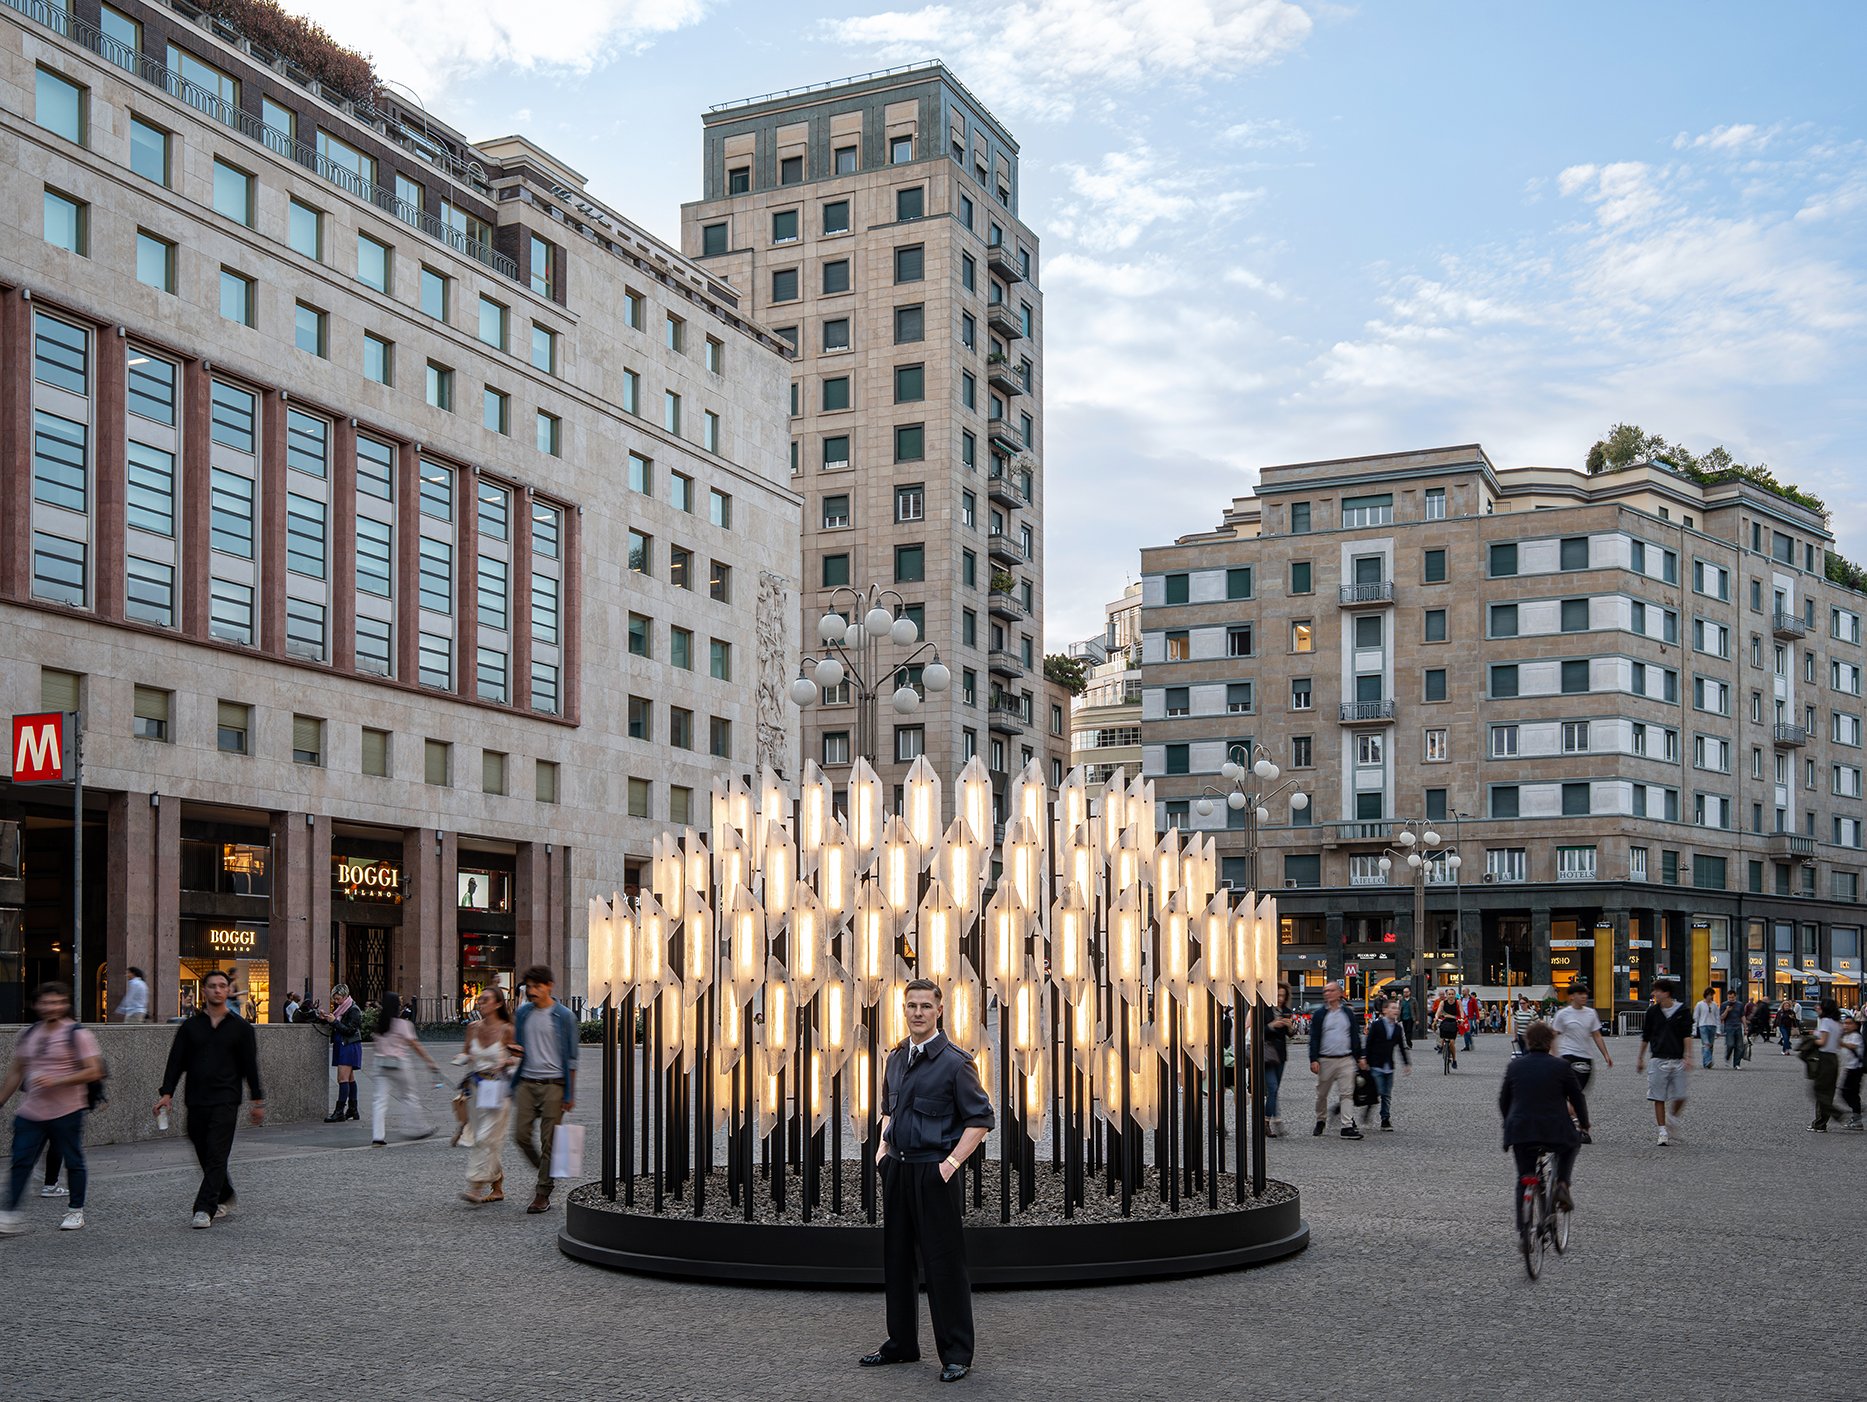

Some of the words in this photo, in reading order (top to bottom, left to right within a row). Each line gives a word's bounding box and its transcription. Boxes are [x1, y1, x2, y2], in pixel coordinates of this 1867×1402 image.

[16, 724, 61, 772] M
[338, 864, 398, 887] BOGGI
[1353, 876, 1385, 884] AIELLO
[1559, 871, 1595, 879] HOTELS
[344, 888, 391, 898] MILANO
[210, 929, 255, 944] BOGGI
